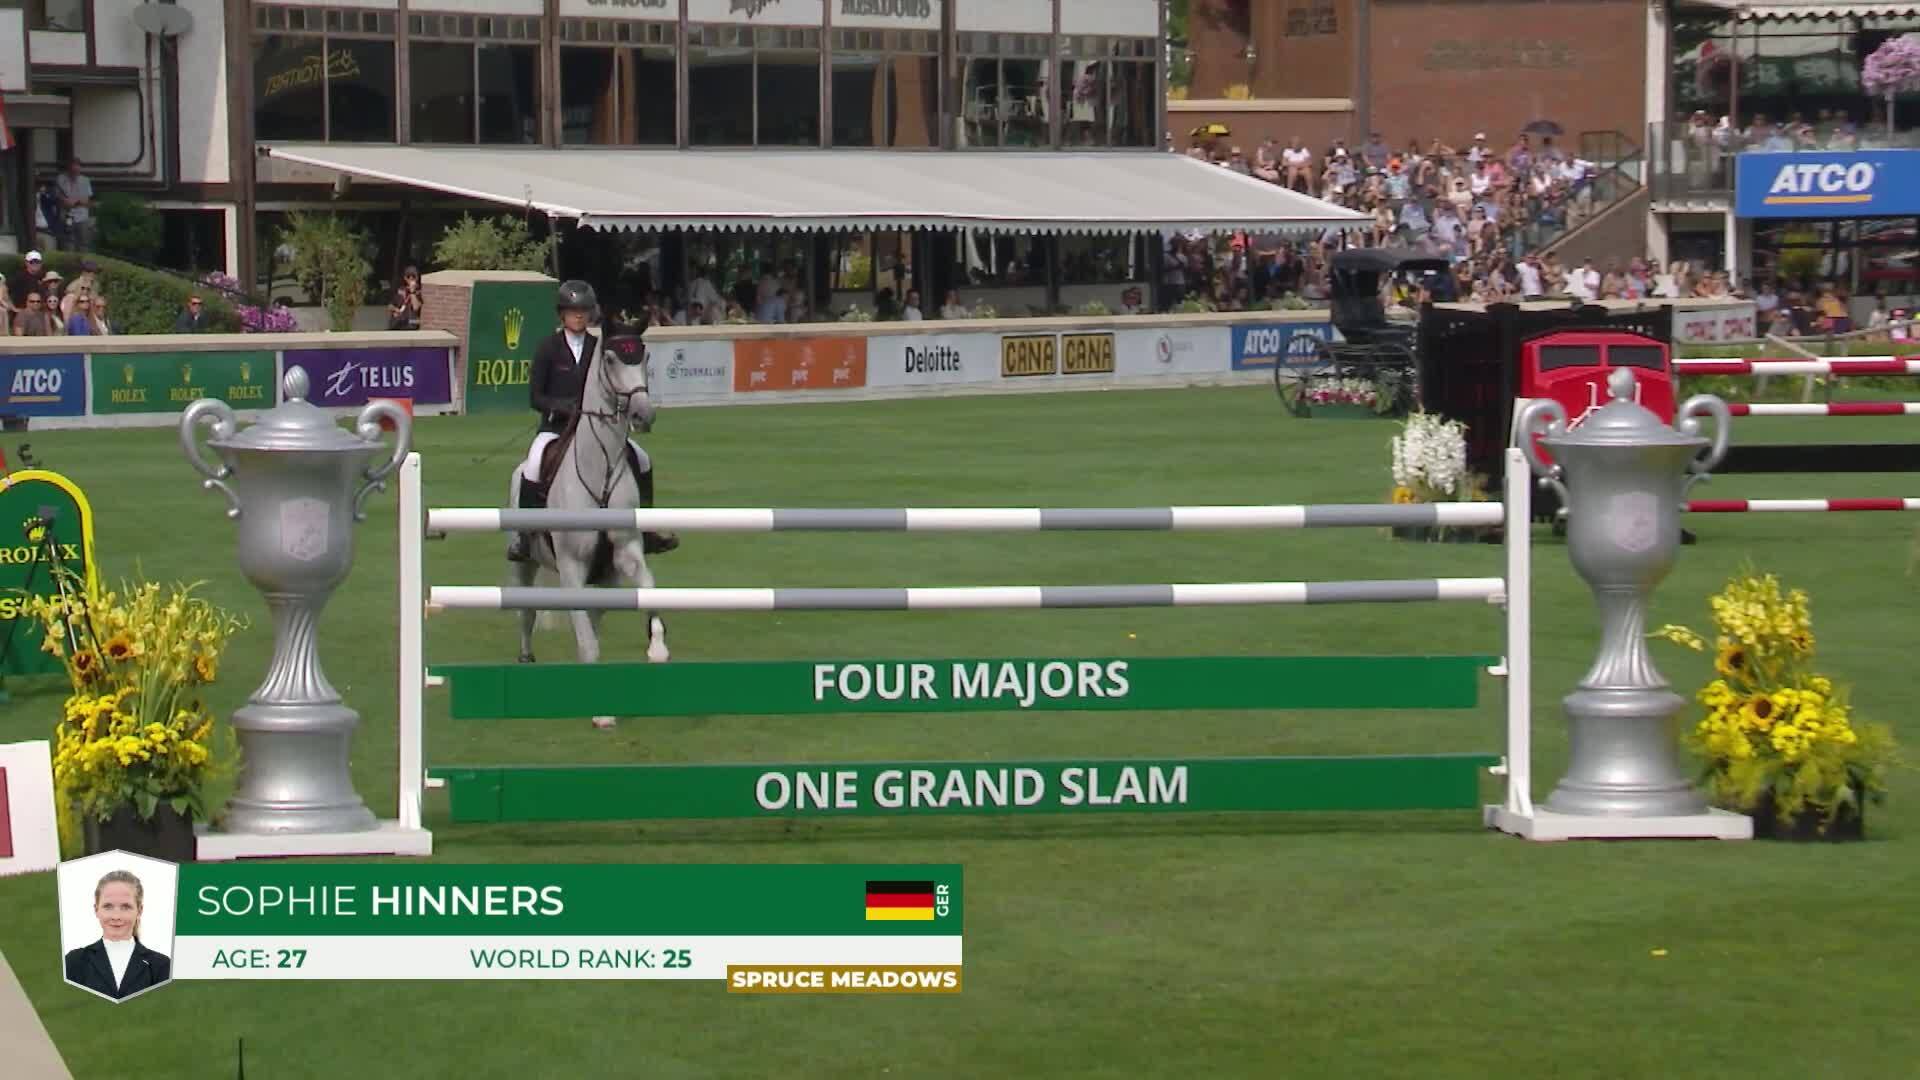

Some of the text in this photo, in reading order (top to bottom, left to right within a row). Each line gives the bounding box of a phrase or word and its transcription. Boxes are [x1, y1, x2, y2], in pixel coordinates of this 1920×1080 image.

[1769, 161, 1875, 193] ATCO
[1065, 338, 1112, 369] CANA
[1244, 329, 1280, 354] ATCO
[905, 346, 960, 373] Deloitte
[1006, 341, 1055, 372] CANA
[11, 368, 62, 393] ATCO
[360, 366, 414, 387] TELUS
[476, 360, 533, 386] ROLE
[111, 388, 147, 403] ROLEX
[170, 386, 206, 401] ROLEX
[229, 385, 263, 399] ROLEX
[813, 660, 1129, 708] FOUR MAJORS
[755, 766, 1188, 810] ONE GRAND SLAM
